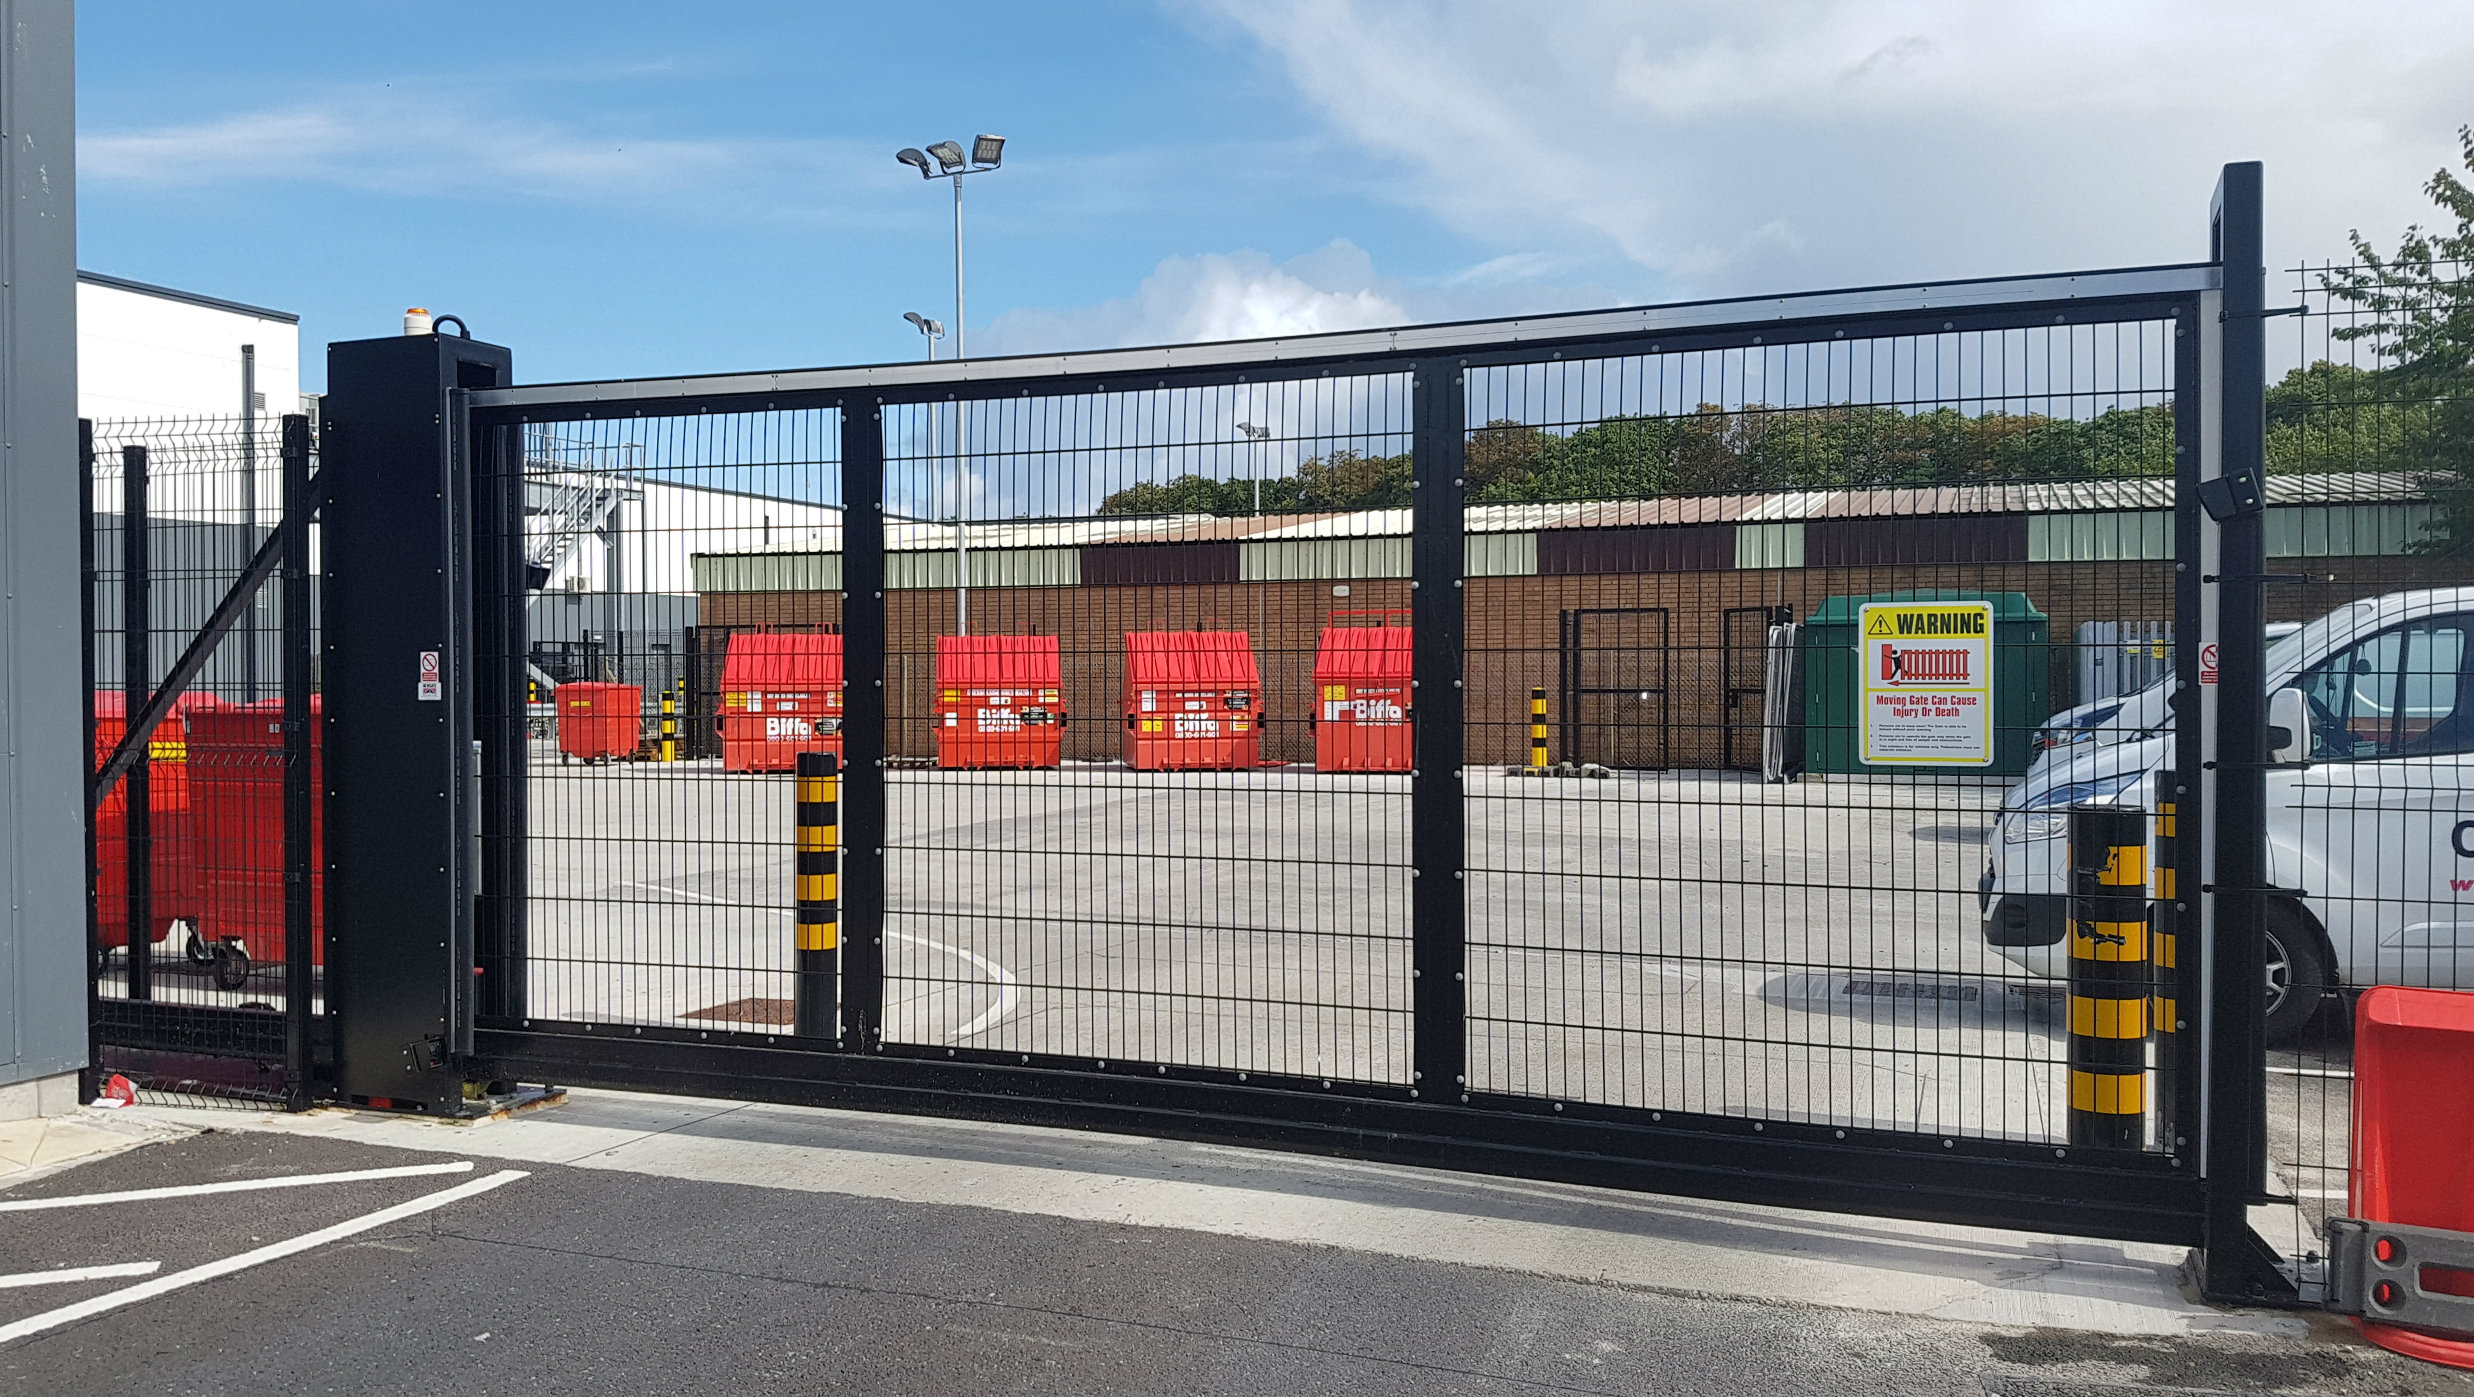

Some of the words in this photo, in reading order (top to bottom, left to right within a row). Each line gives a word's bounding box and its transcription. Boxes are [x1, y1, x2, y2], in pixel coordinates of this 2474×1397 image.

[1896, 612, 1985, 635] WARNING
[1355, 699, 1402, 719] Biffa
[1876, 694, 1907, 707] Moving
[1909, 695, 1929, 706] Gate
[1931, 695, 1948, 706] Can
[1950, 695, 1977, 706] Cause
[1893, 705, 1919, 718] Injury
[1921, 707, 1933, 717] Or
[1935, 707, 1960, 717] Death
[766, 717, 812, 735] Biffa
